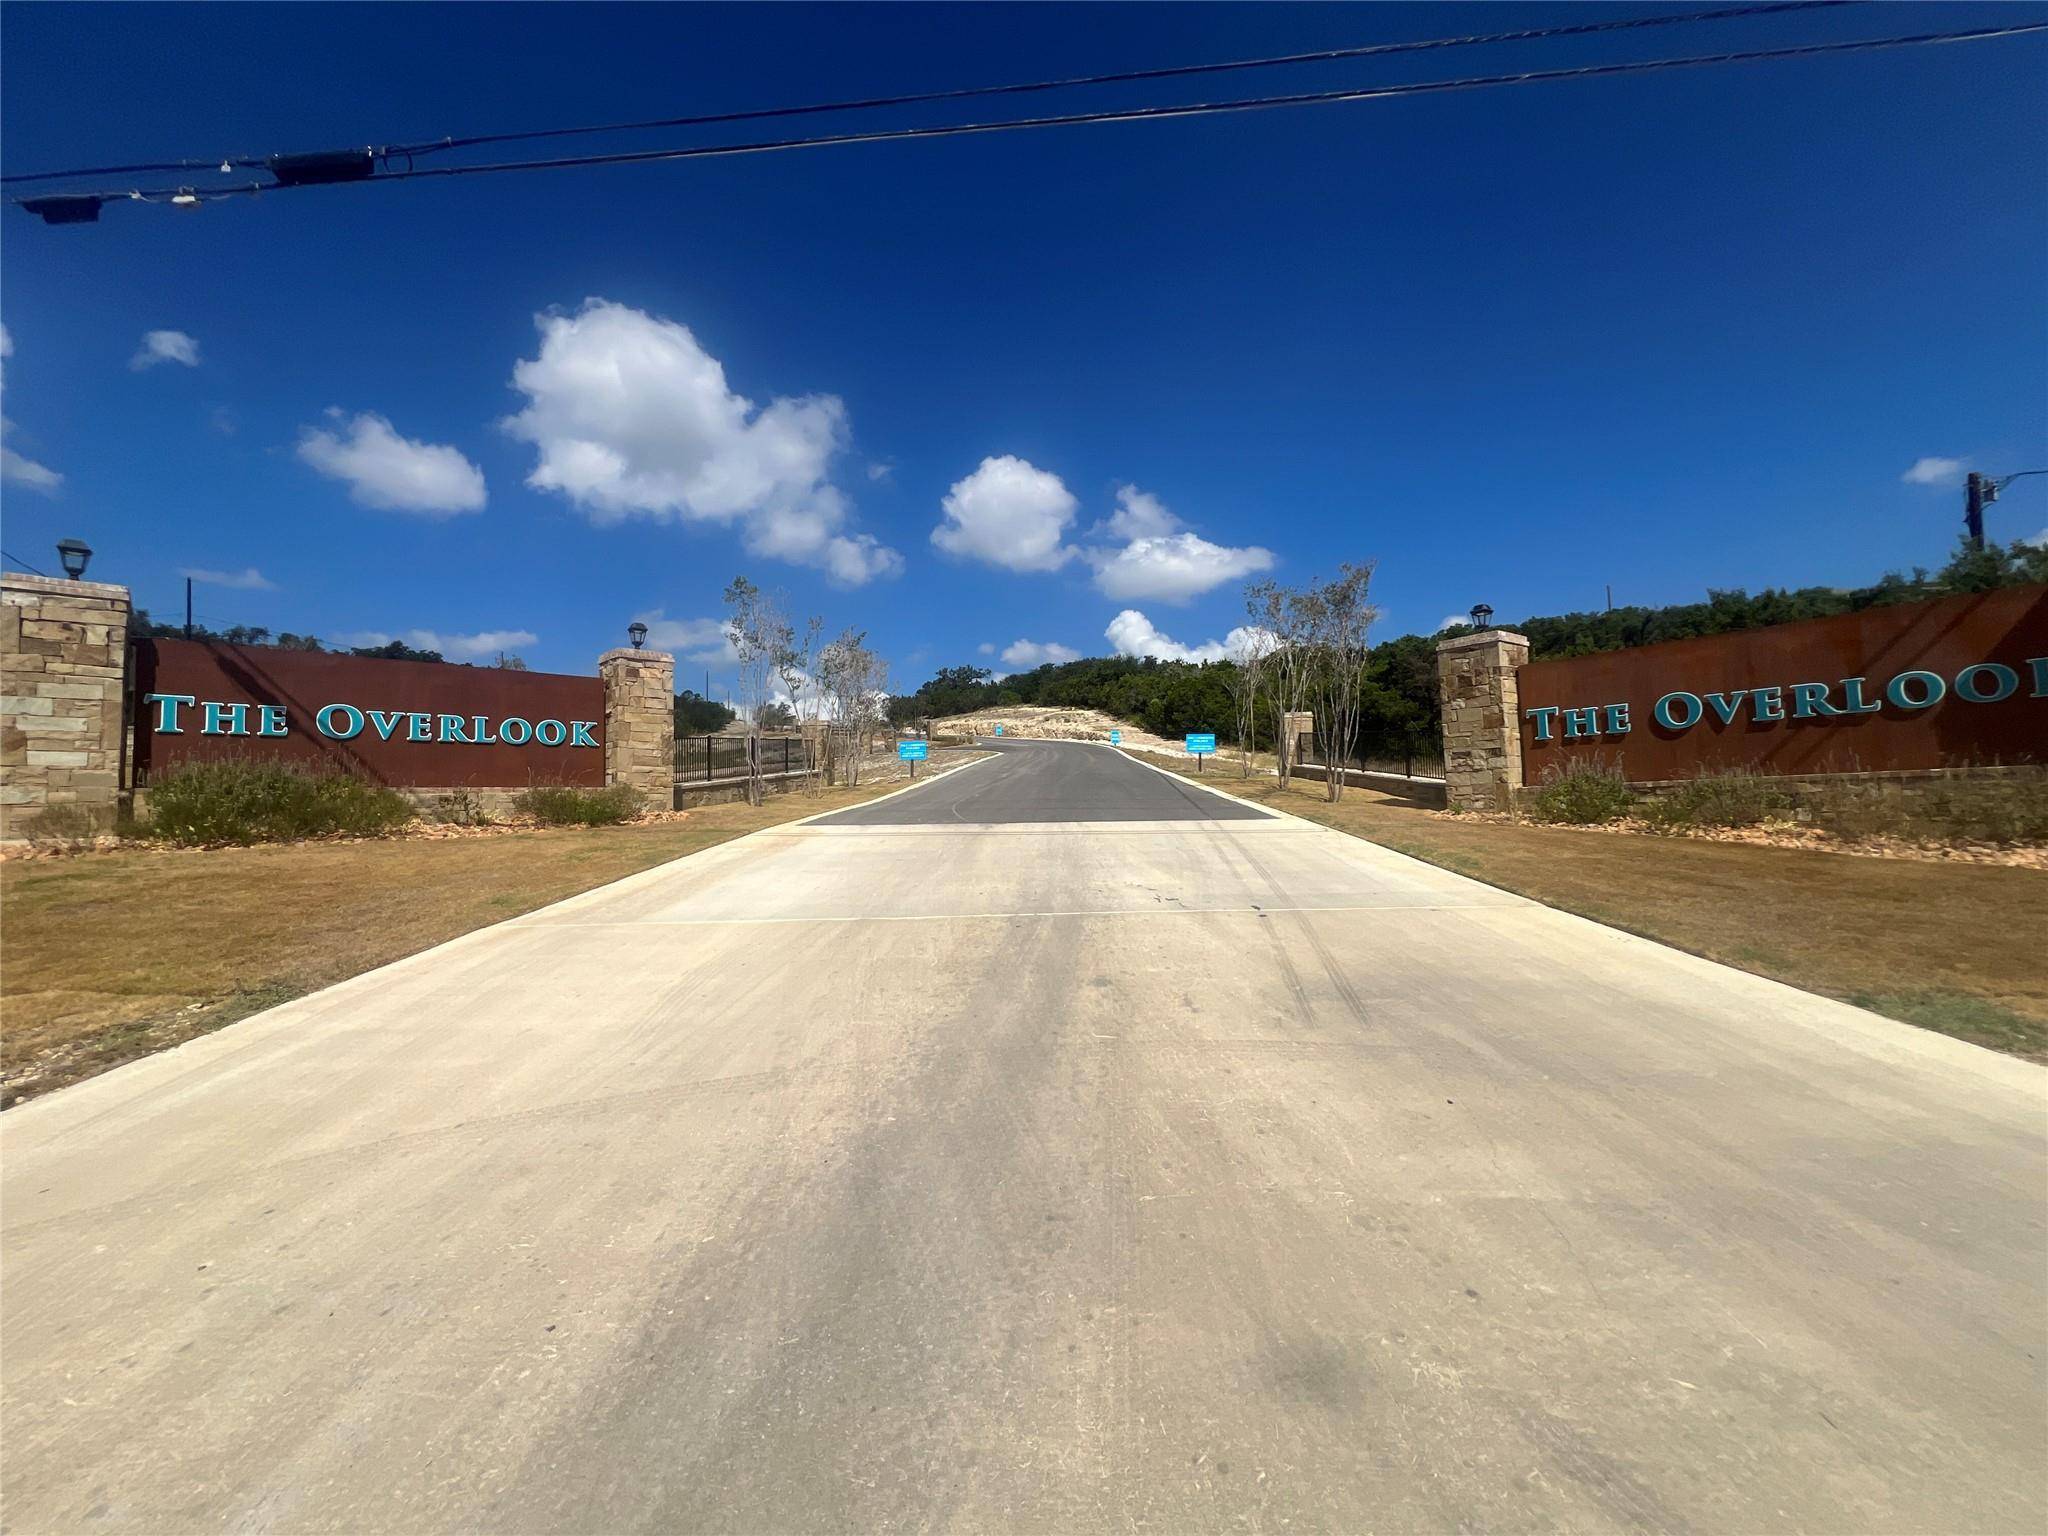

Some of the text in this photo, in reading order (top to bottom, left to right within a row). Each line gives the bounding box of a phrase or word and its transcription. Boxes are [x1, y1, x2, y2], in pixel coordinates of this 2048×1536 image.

[145, 694, 600, 748] THE OVERLOOK
[1526, 702, 1631, 740] THE
